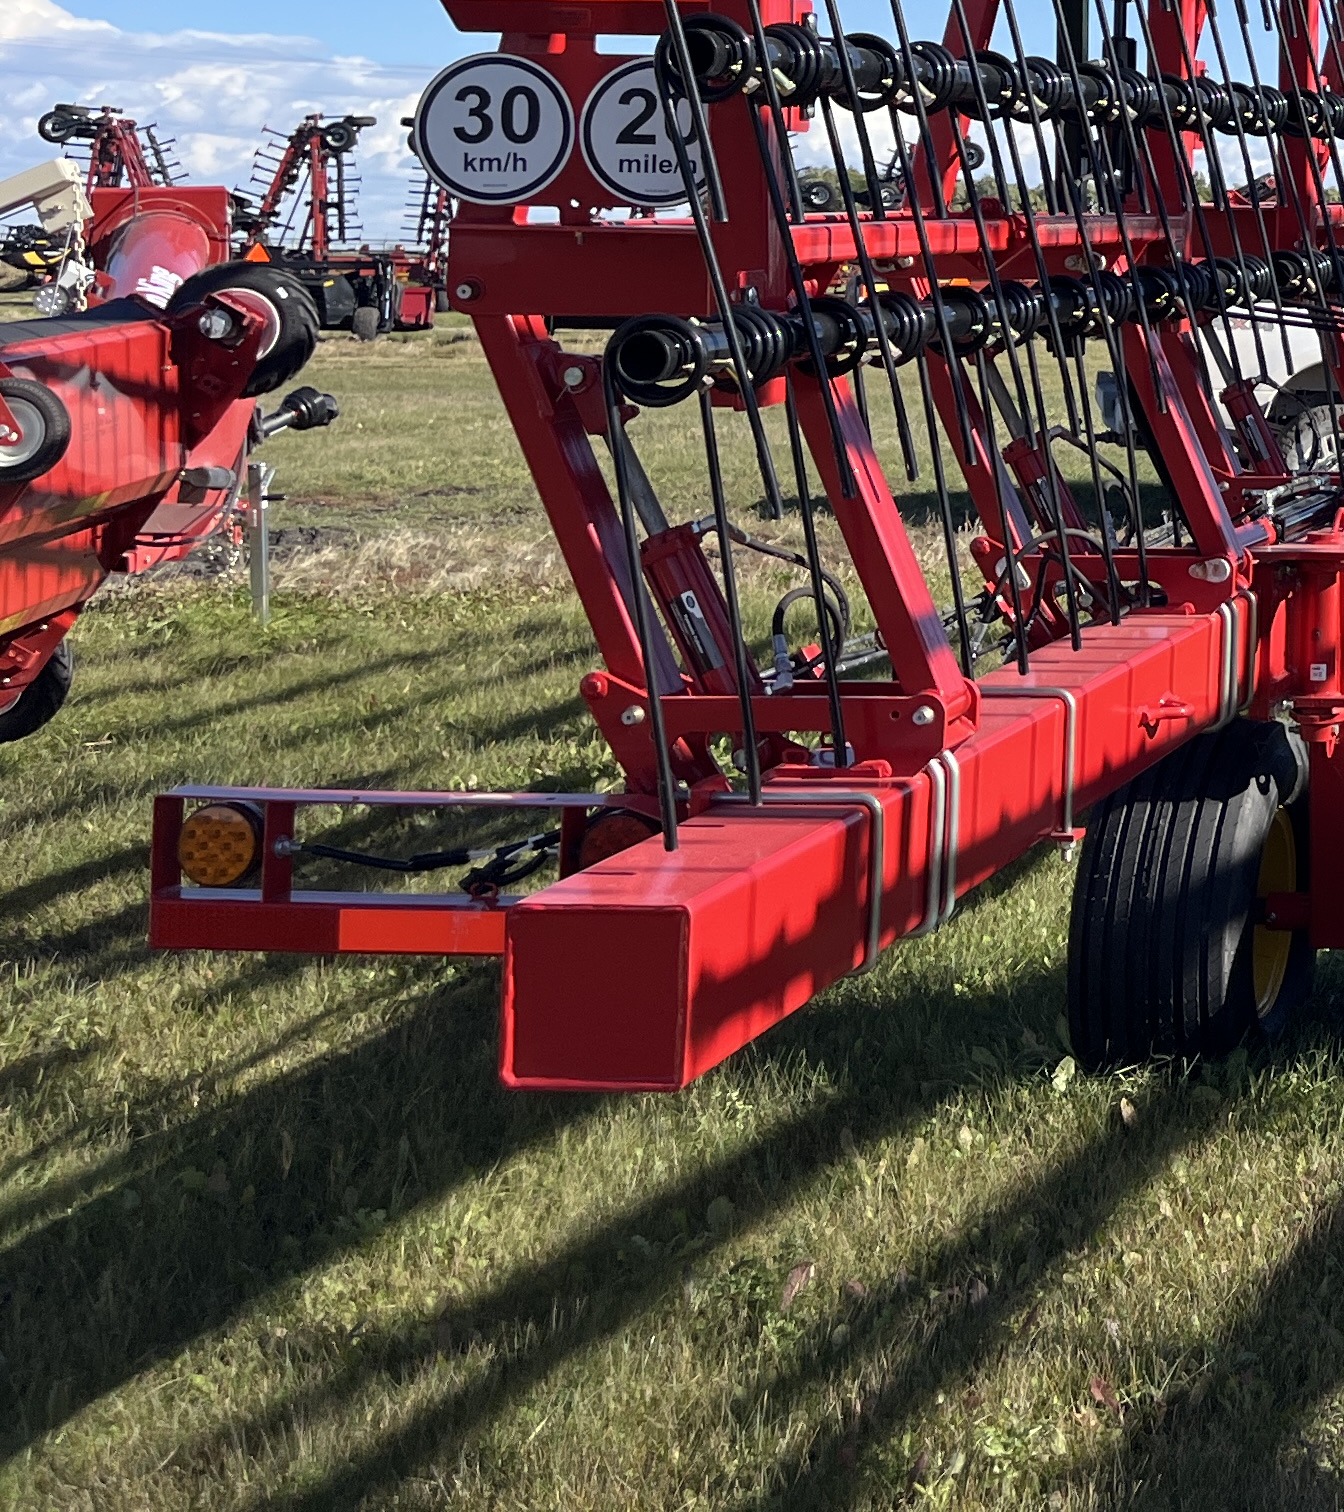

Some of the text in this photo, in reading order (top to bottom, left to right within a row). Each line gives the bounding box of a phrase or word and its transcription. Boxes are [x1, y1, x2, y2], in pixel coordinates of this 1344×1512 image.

[453, 85, 540, 144] 30
[615, 88, 700, 146] 20
[463, 151, 527, 173] km/h
